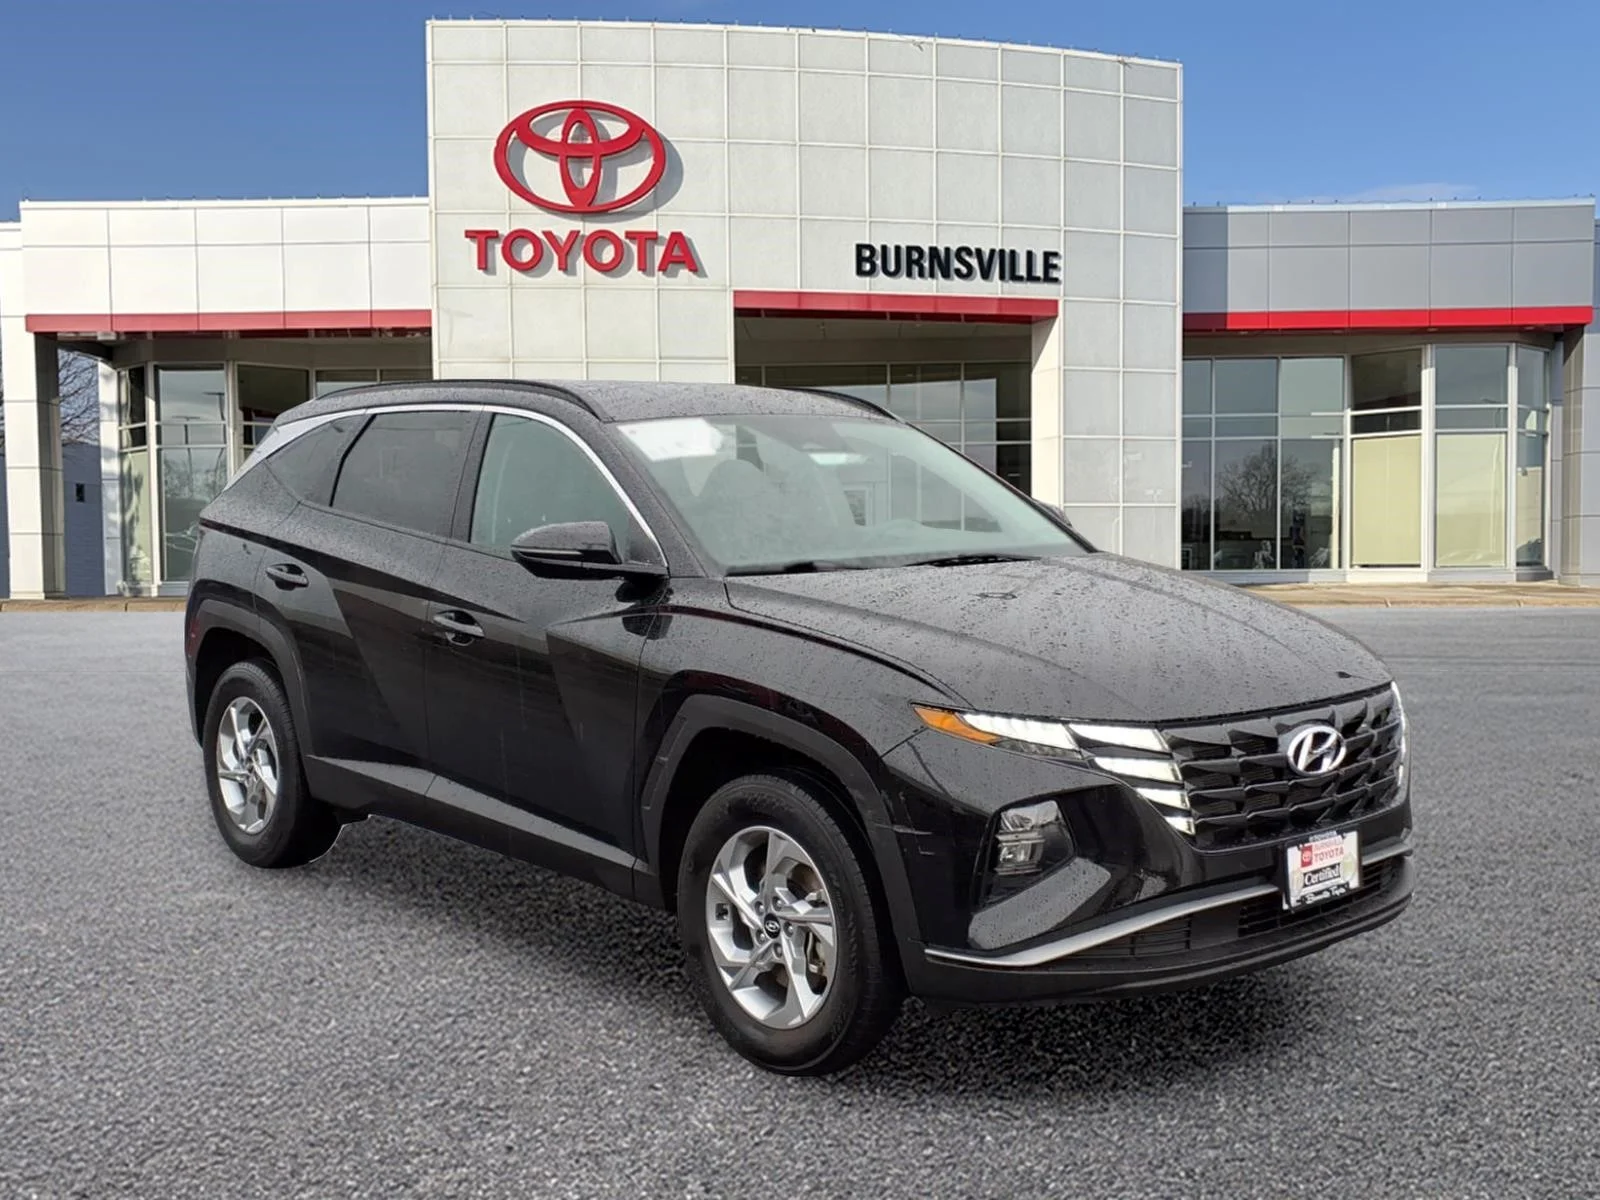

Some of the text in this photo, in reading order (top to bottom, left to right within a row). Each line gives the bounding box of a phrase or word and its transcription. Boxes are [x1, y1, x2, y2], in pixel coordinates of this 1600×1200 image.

[465, 229, 698, 273] TOYOTA
[856, 243, 1061, 283] BURNSVILLE
[1313, 847, 1344, 862] TOYOTA
